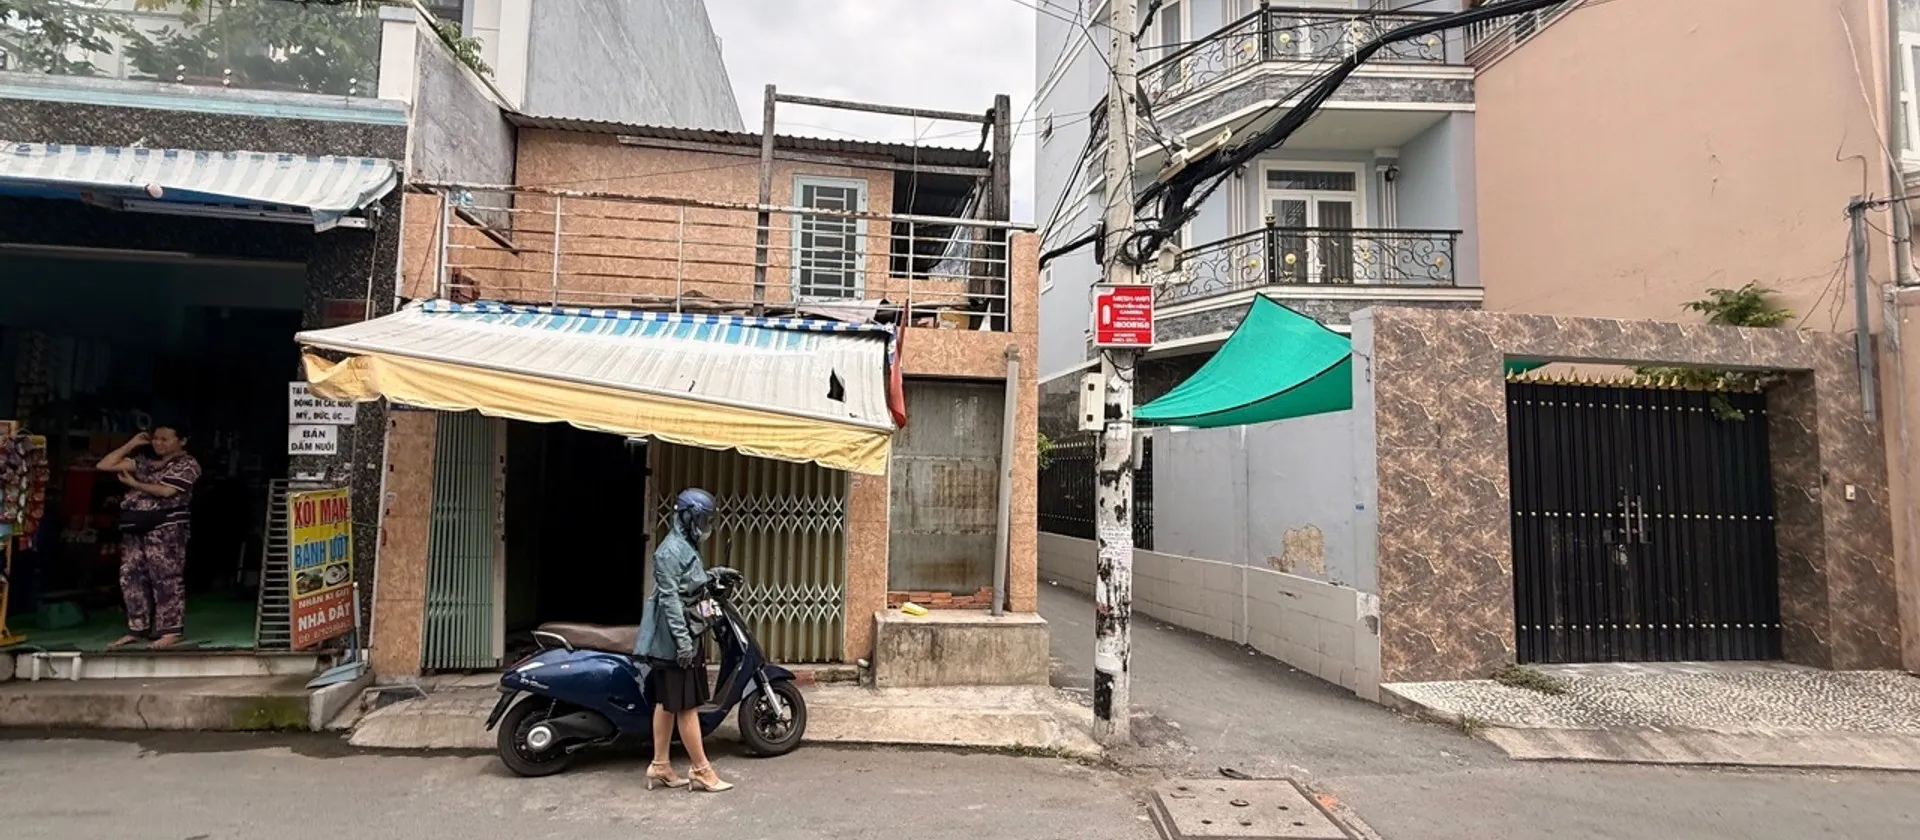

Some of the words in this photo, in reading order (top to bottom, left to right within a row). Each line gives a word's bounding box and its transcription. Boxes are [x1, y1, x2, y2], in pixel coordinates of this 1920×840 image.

[302, 428, 326, 438] BÁN
[293, 495, 316, 529] XÔI
[294, 538, 327, 568] BÁNH
[298, 607, 327, 632] NHÀ
